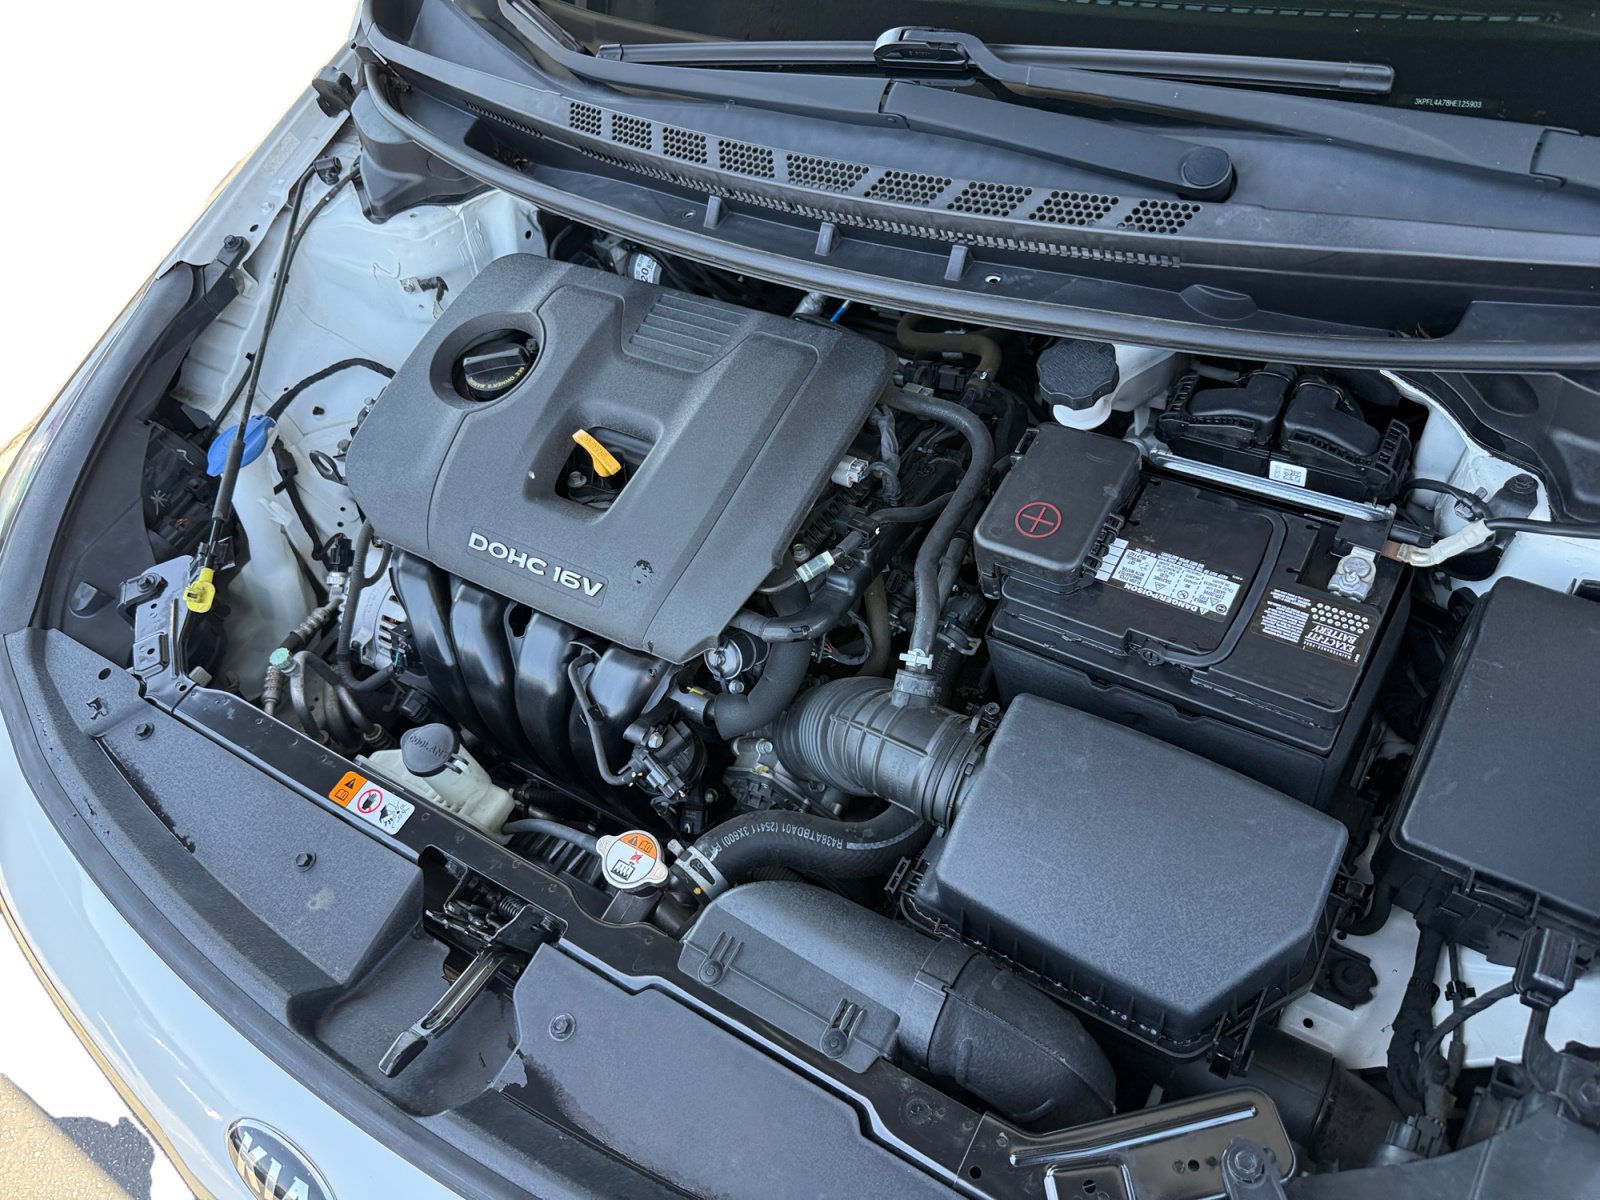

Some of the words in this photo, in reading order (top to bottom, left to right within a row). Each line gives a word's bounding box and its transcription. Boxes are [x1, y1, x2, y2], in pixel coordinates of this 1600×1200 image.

[1414, 97, 1482, 108] 3KPFL4A78HE125903
[468, 532, 549, 576] DOHC
[553, 566, 603, 597] 16V
[1123, 582, 1198, 612] DANGER/POISON
[1304, 630, 1355, 653] EXACT-FIT
[1310, 623, 1357, 644] BATTERY
[409, 734, 450, 760] COOLANT
